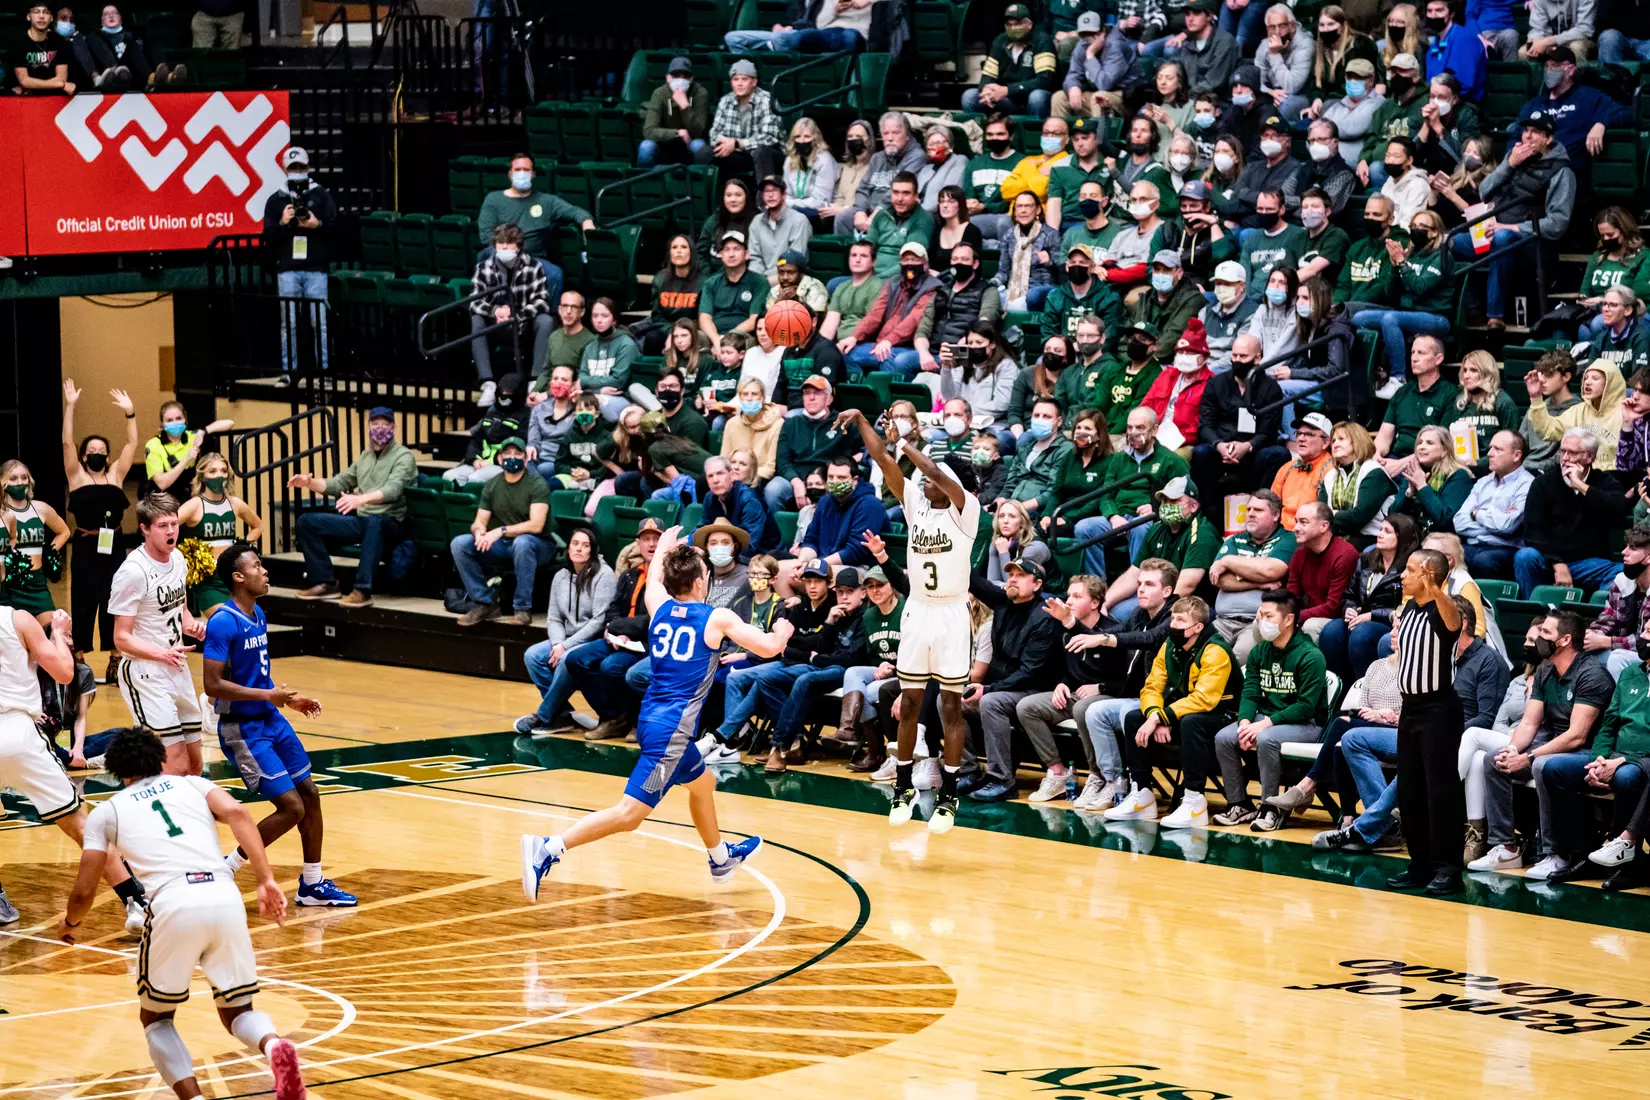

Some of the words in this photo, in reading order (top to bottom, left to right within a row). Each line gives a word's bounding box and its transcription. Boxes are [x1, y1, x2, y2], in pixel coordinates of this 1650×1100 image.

[56, 217, 101, 234] Official
[105, 215, 146, 233] Credit
[149, 213, 187, 231] Union
[190, 212, 203, 229] of
[205, 211, 234, 228] CSU
[1591, 269, 1625, 287] CSU
[659, 291, 698, 308] STATE
[17, 527, 44, 544] AMS
[203, 521, 237, 538] RAMS
[912, 525, 949, 547] Colorado
[923, 561, 938, 591] 3
[244, 635, 258, 650] AIR
[651, 622, 697, 663] 30
[259, 648, 268, 677] 5
[1275, 675, 1296, 689] RAMS
[130, 780, 174, 802] TONJE
[151, 799, 184, 838] 1
[1282, 979, 1417, 996] of
[1400, 992, 1630, 1035] Bank
